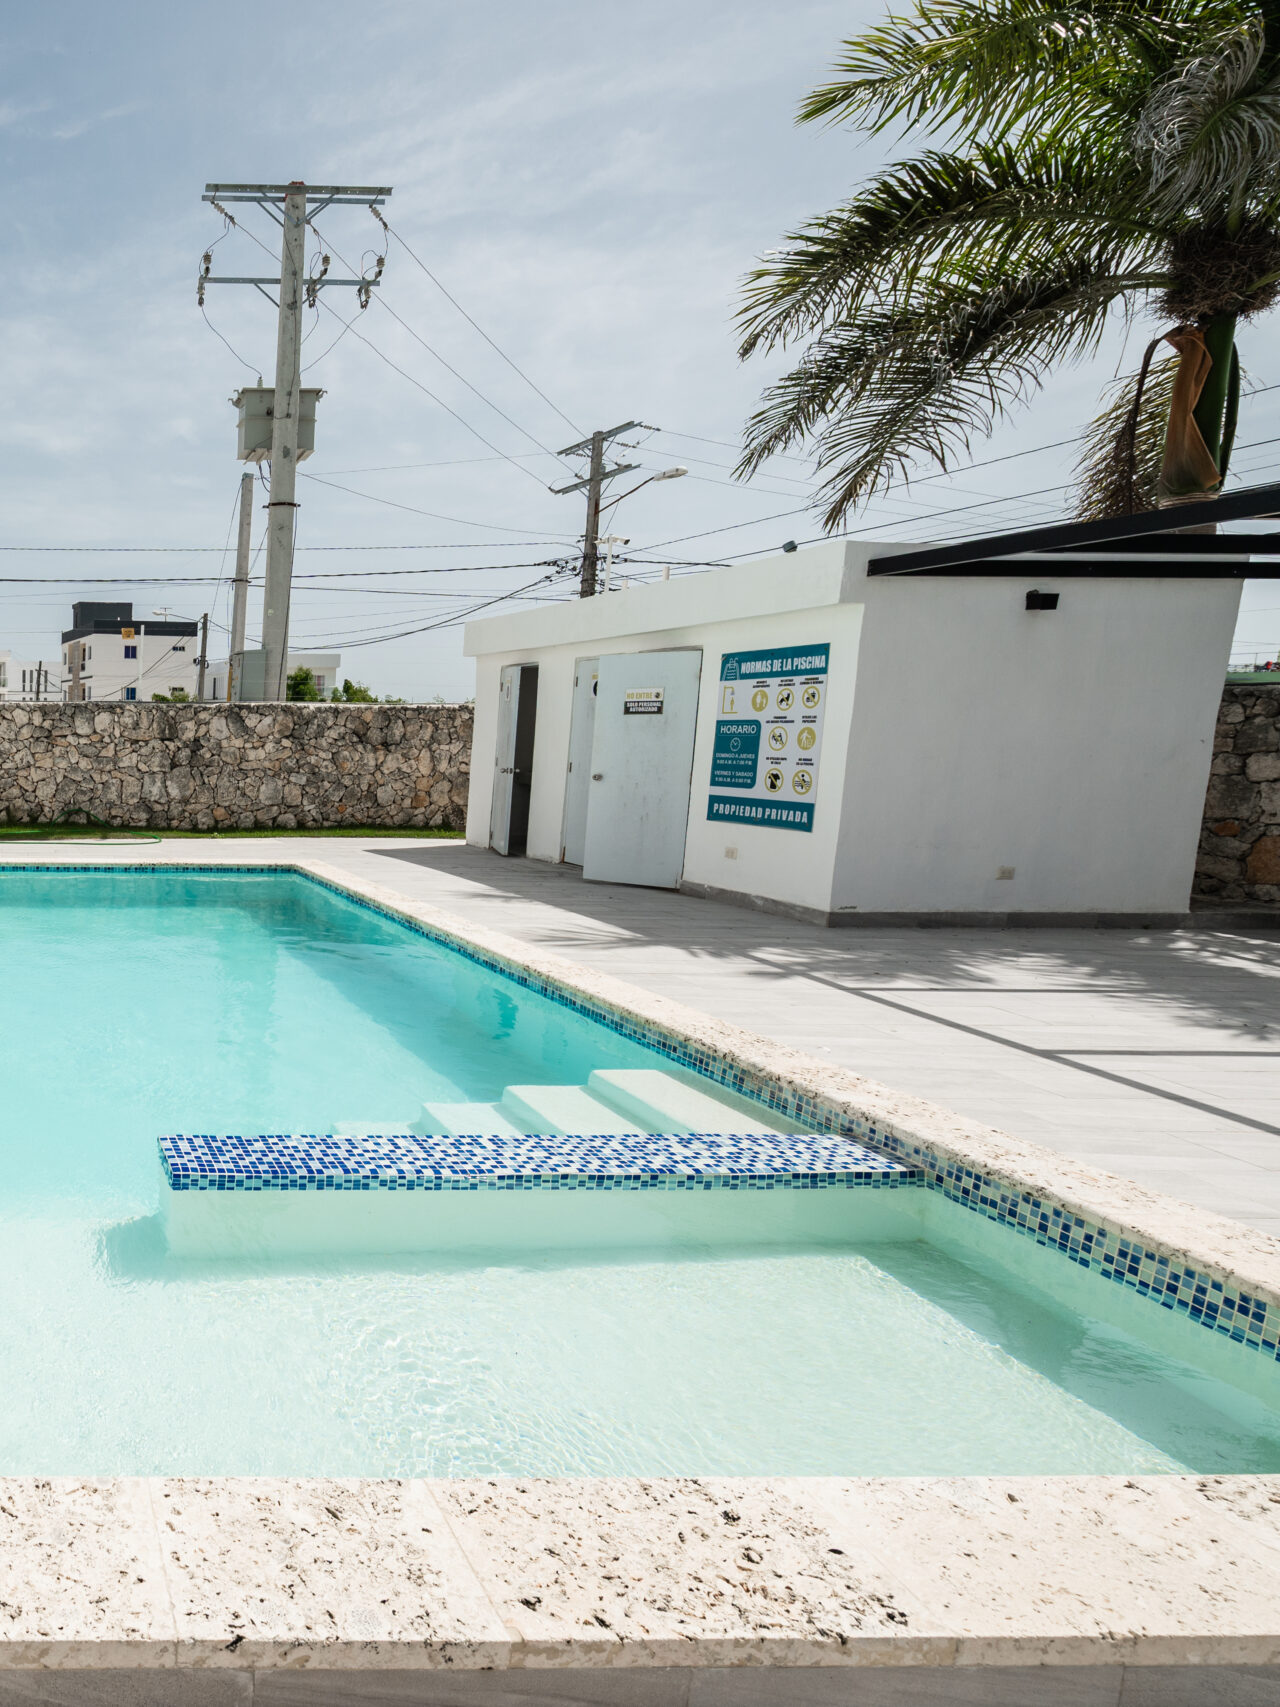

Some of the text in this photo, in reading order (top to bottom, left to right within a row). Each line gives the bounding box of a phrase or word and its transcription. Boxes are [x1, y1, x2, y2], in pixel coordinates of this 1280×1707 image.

[741, 655, 826, 674] NORMAS DE LA PISCINA
[720, 725, 757, 734] HORARIO
[713, 803, 808, 823] PROPIEDAD PRIVADA
